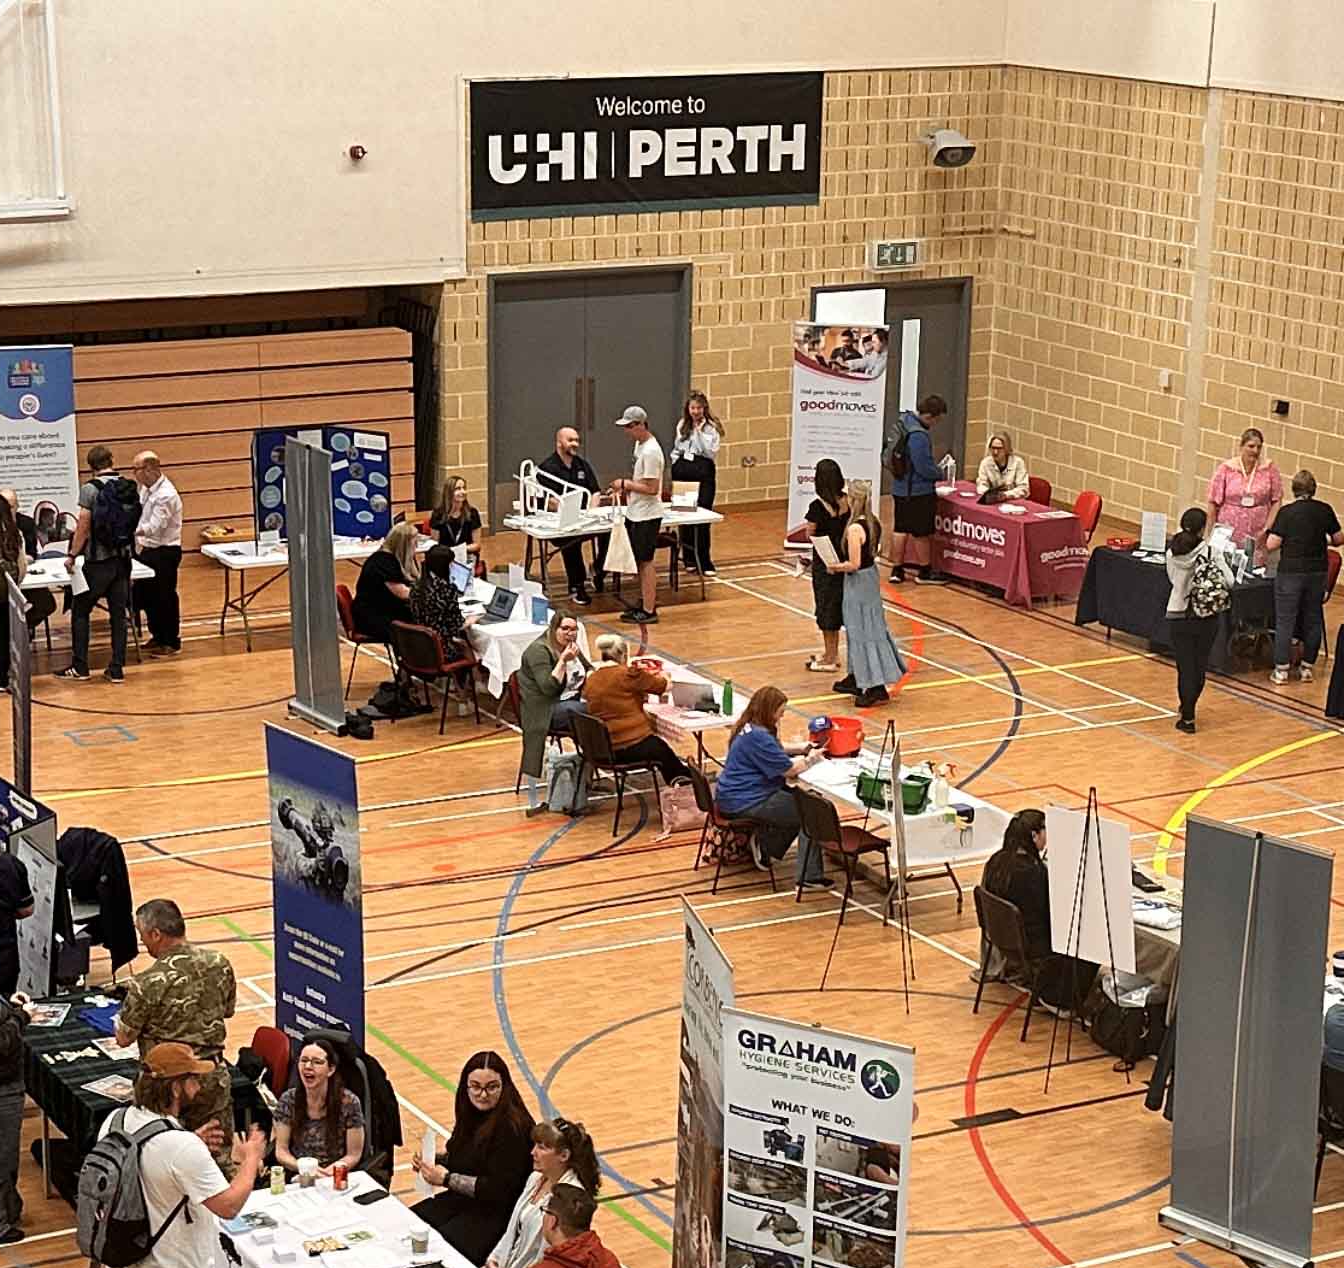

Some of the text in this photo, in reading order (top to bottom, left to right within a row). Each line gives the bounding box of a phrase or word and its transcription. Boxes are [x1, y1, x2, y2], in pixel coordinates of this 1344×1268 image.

[595, 96, 706, 117] Welcome to
[488, 123, 807, 185] UHI PERTH
[800, 399, 877, 413] goodmoves
[935, 515, 1006, 546] oodmoves
[737, 1029, 857, 1072] GRAHAM
[739, 1050, 856, 1084] HYGIENE SERVICES
[771, 1099, 808, 1116] WHAT
[812, 1107, 831, 1122] WE
[834, 1114, 856, 1129] DO:
